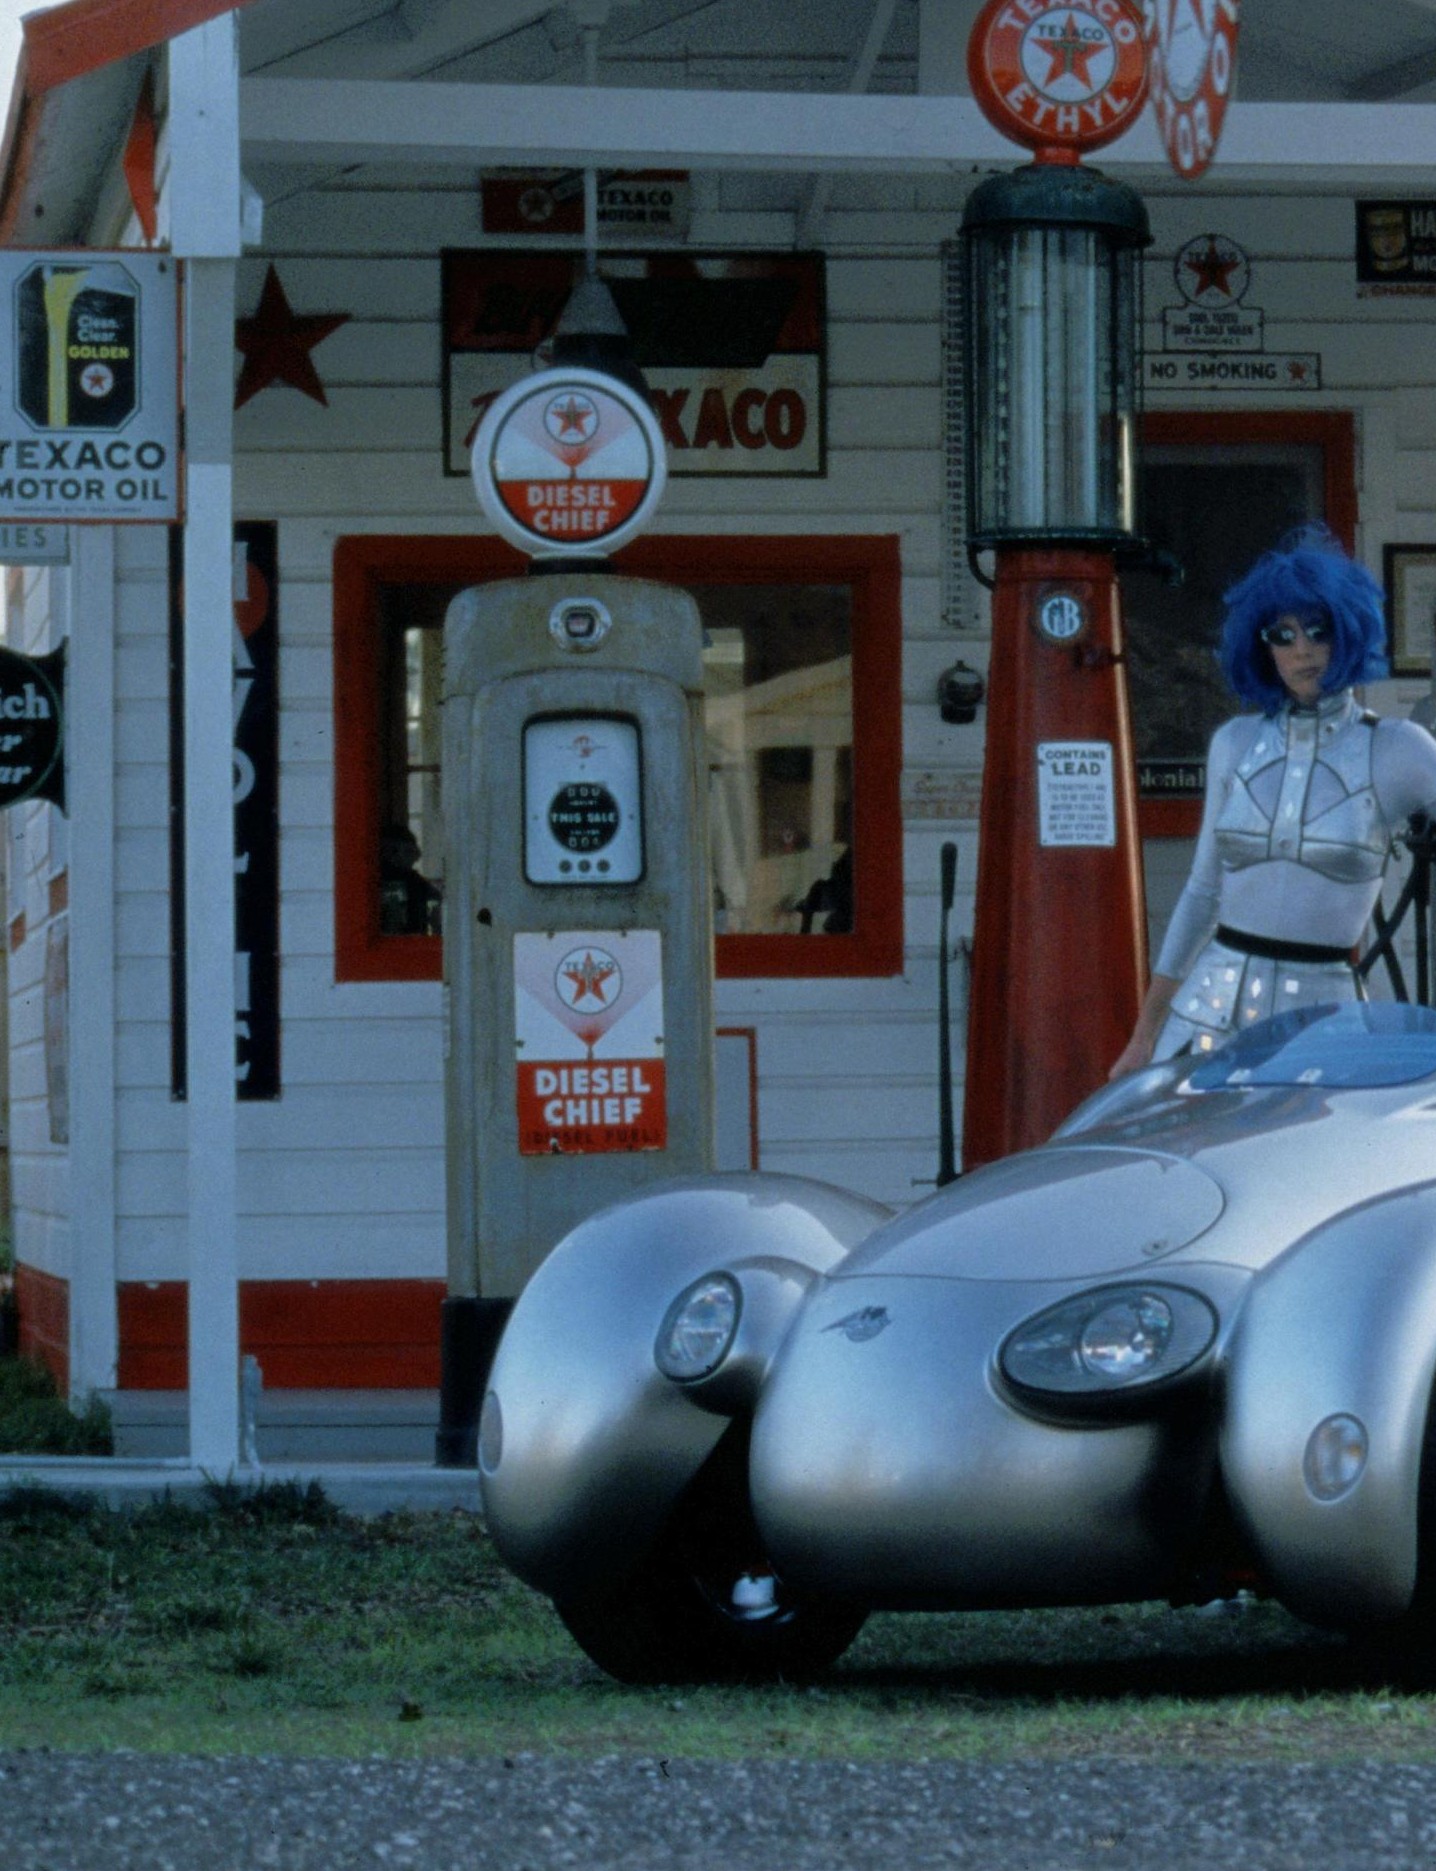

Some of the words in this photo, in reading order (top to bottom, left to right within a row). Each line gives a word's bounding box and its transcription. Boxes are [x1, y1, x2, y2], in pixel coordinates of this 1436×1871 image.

[1006, 81, 1128, 133] ETHYL
[69, 346, 129, 359] GOLDEN
[1150, 361, 1178, 379] NO
[1187, 361, 1278, 380] SMOKING
[114, 477, 169, 501] OIL
[527, 485, 616, 507] DIESEL
[533, 510, 609, 531] CHIEF
[1045, 750, 1107, 760] CONTAINS
[1051, 761, 1102, 776] LEAD
[535, 1067, 651, 1096] DIESEL
[543, 1096, 642, 1127] CHIEF
